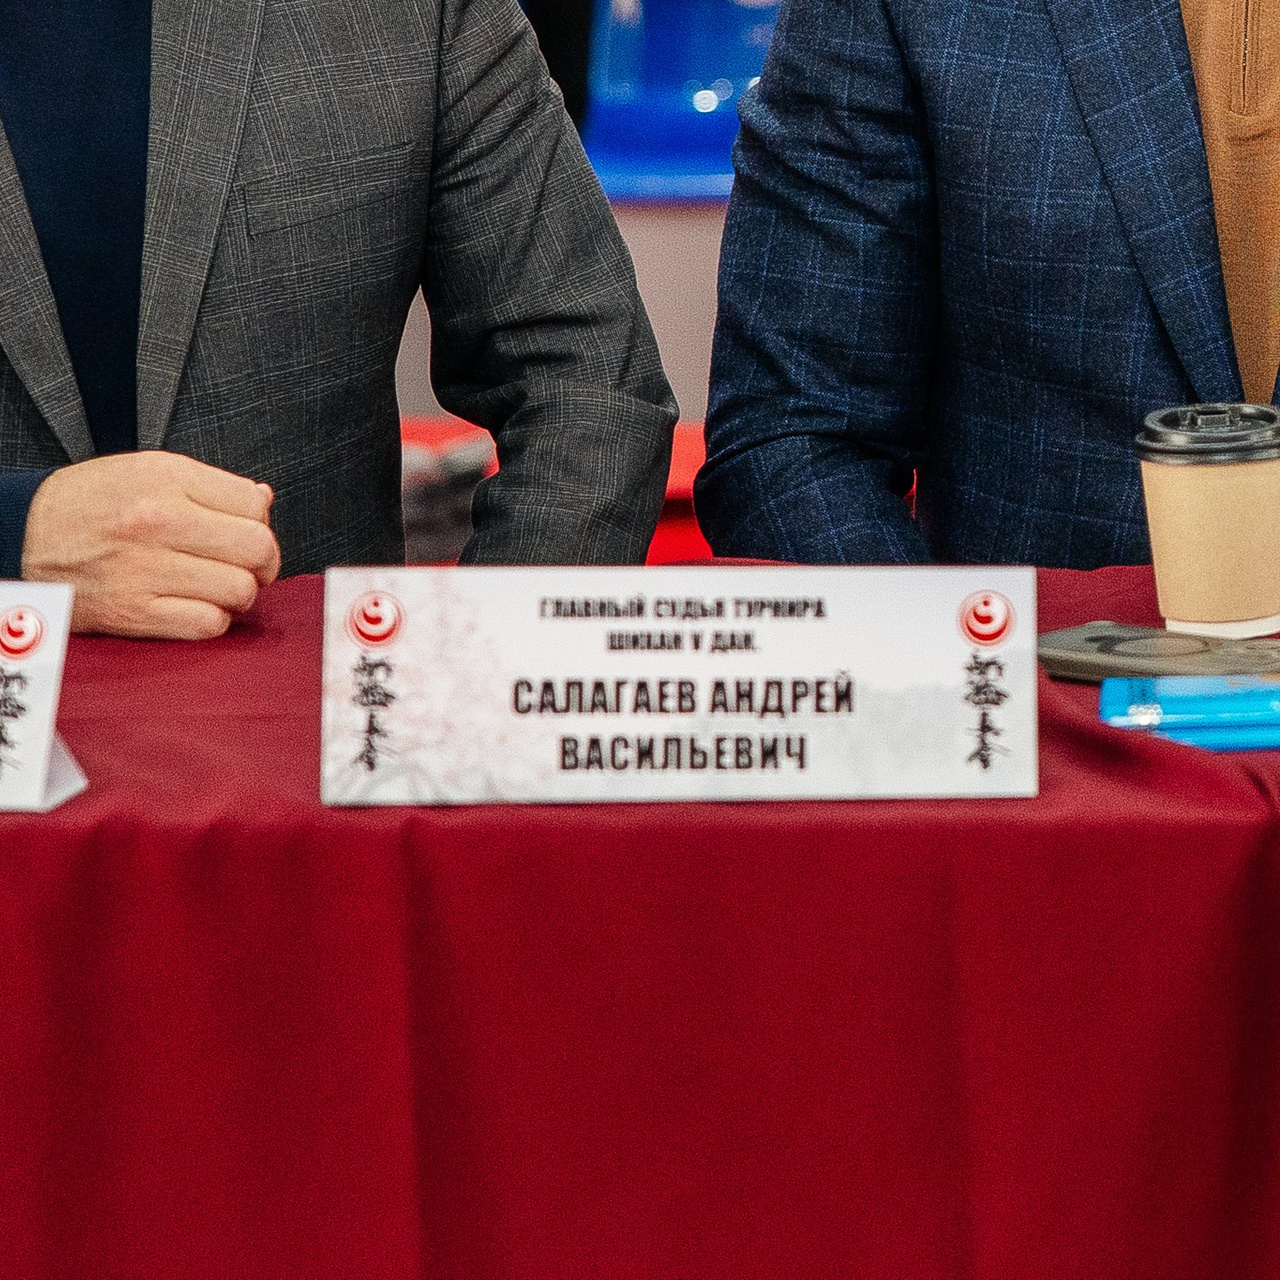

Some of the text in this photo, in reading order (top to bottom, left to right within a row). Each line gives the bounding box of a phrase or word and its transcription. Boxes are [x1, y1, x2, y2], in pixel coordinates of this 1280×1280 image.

[513, 670, 853, 718] САЛАГАЕВ АНДРЕЙ
[560, 734, 805, 771] ВАСИЛЬЕВИЧ
